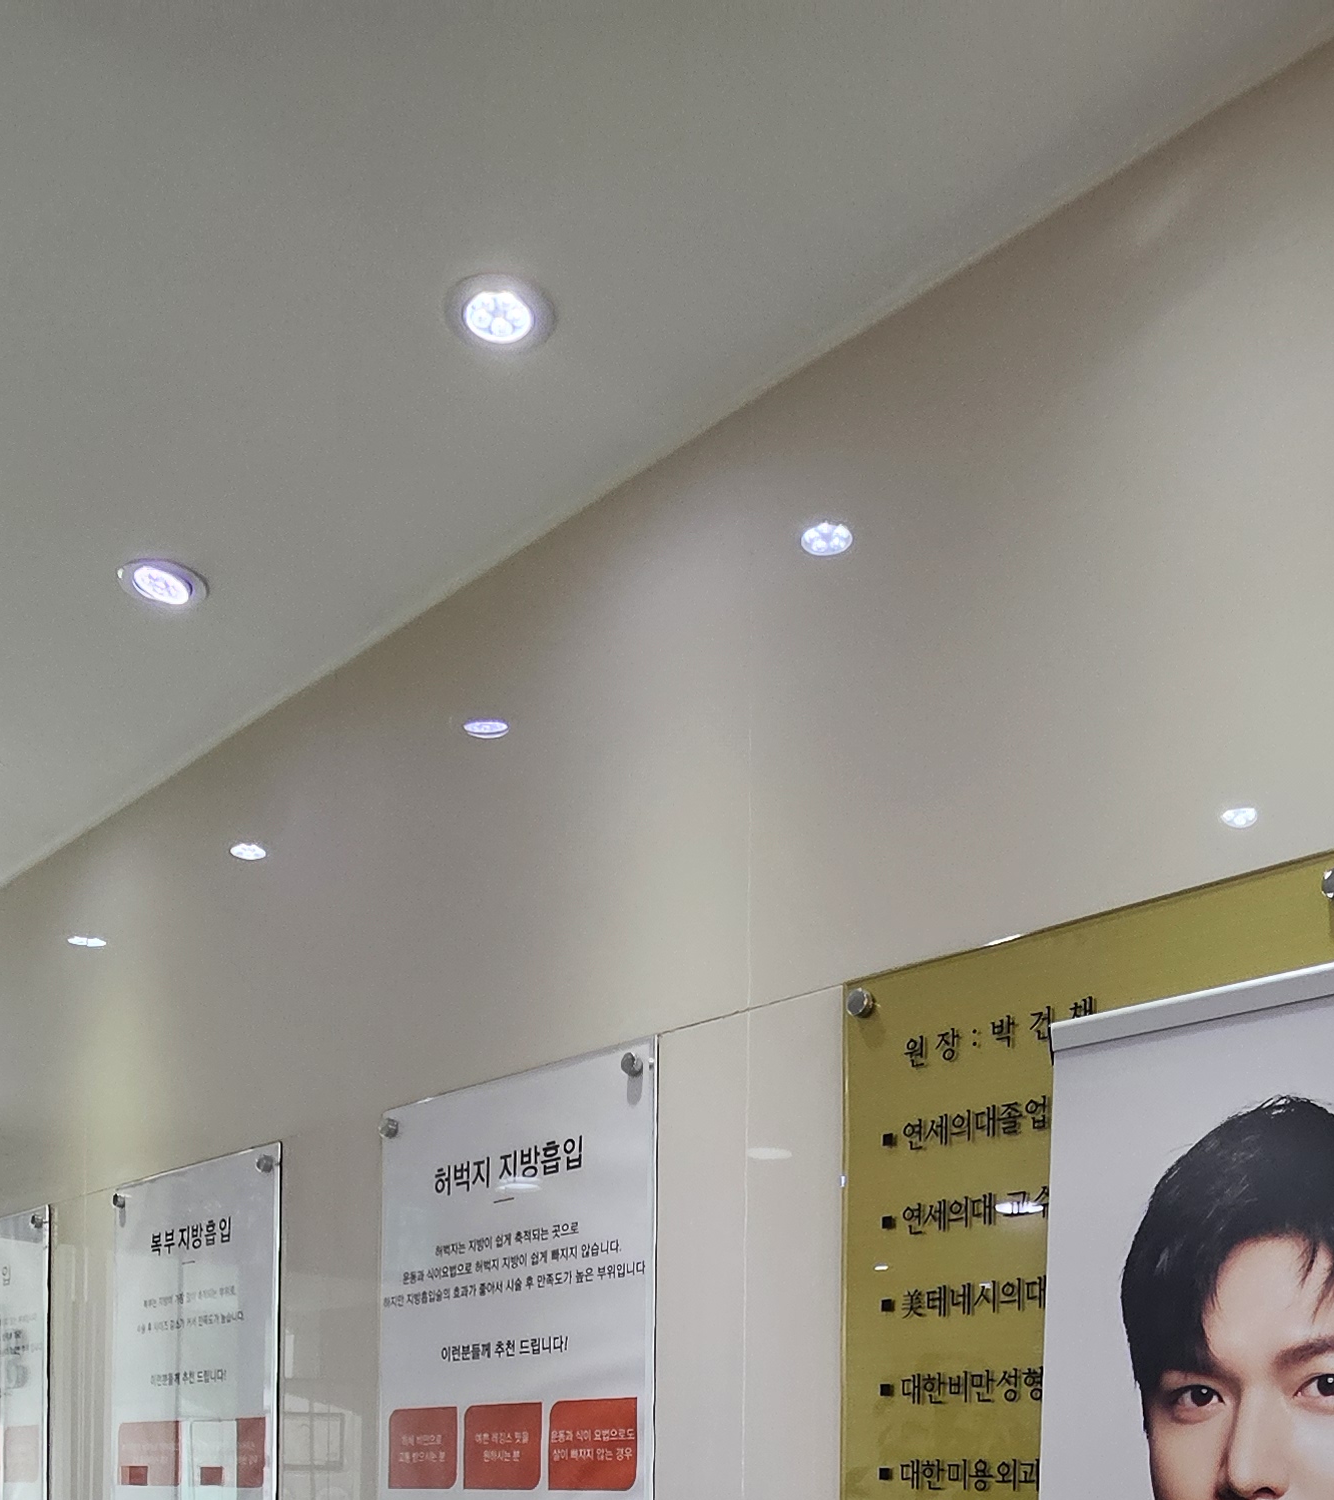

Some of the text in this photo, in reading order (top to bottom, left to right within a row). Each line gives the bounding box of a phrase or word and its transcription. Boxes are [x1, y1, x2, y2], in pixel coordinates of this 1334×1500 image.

[903, 1095, 1049, 1150] 연세의대졸업
[434, 1135, 583, 1196] 허벅지 지방흡입
[902, 1192, 994, 1235] 연세의대
[514, 1227, 549, 1243] 축적되는
[552, 1222, 579, 1239] 곳으로
[475, 1258, 499, 1273] 허벅지
[502, 1252, 527, 1269] 지방이
[531, 1250, 548, 1266] 쉽게
[551, 1245, 578, 1262] 빠지지
[537, 1270, 572, 1288] 만족도가
[575, 1267, 594, 1284] 높은
[597, 1260, 646, 1279] 부위입니다
[494, 1339, 516, 1358] 추천
[519, 1334, 569, 1355] 드립니다!
